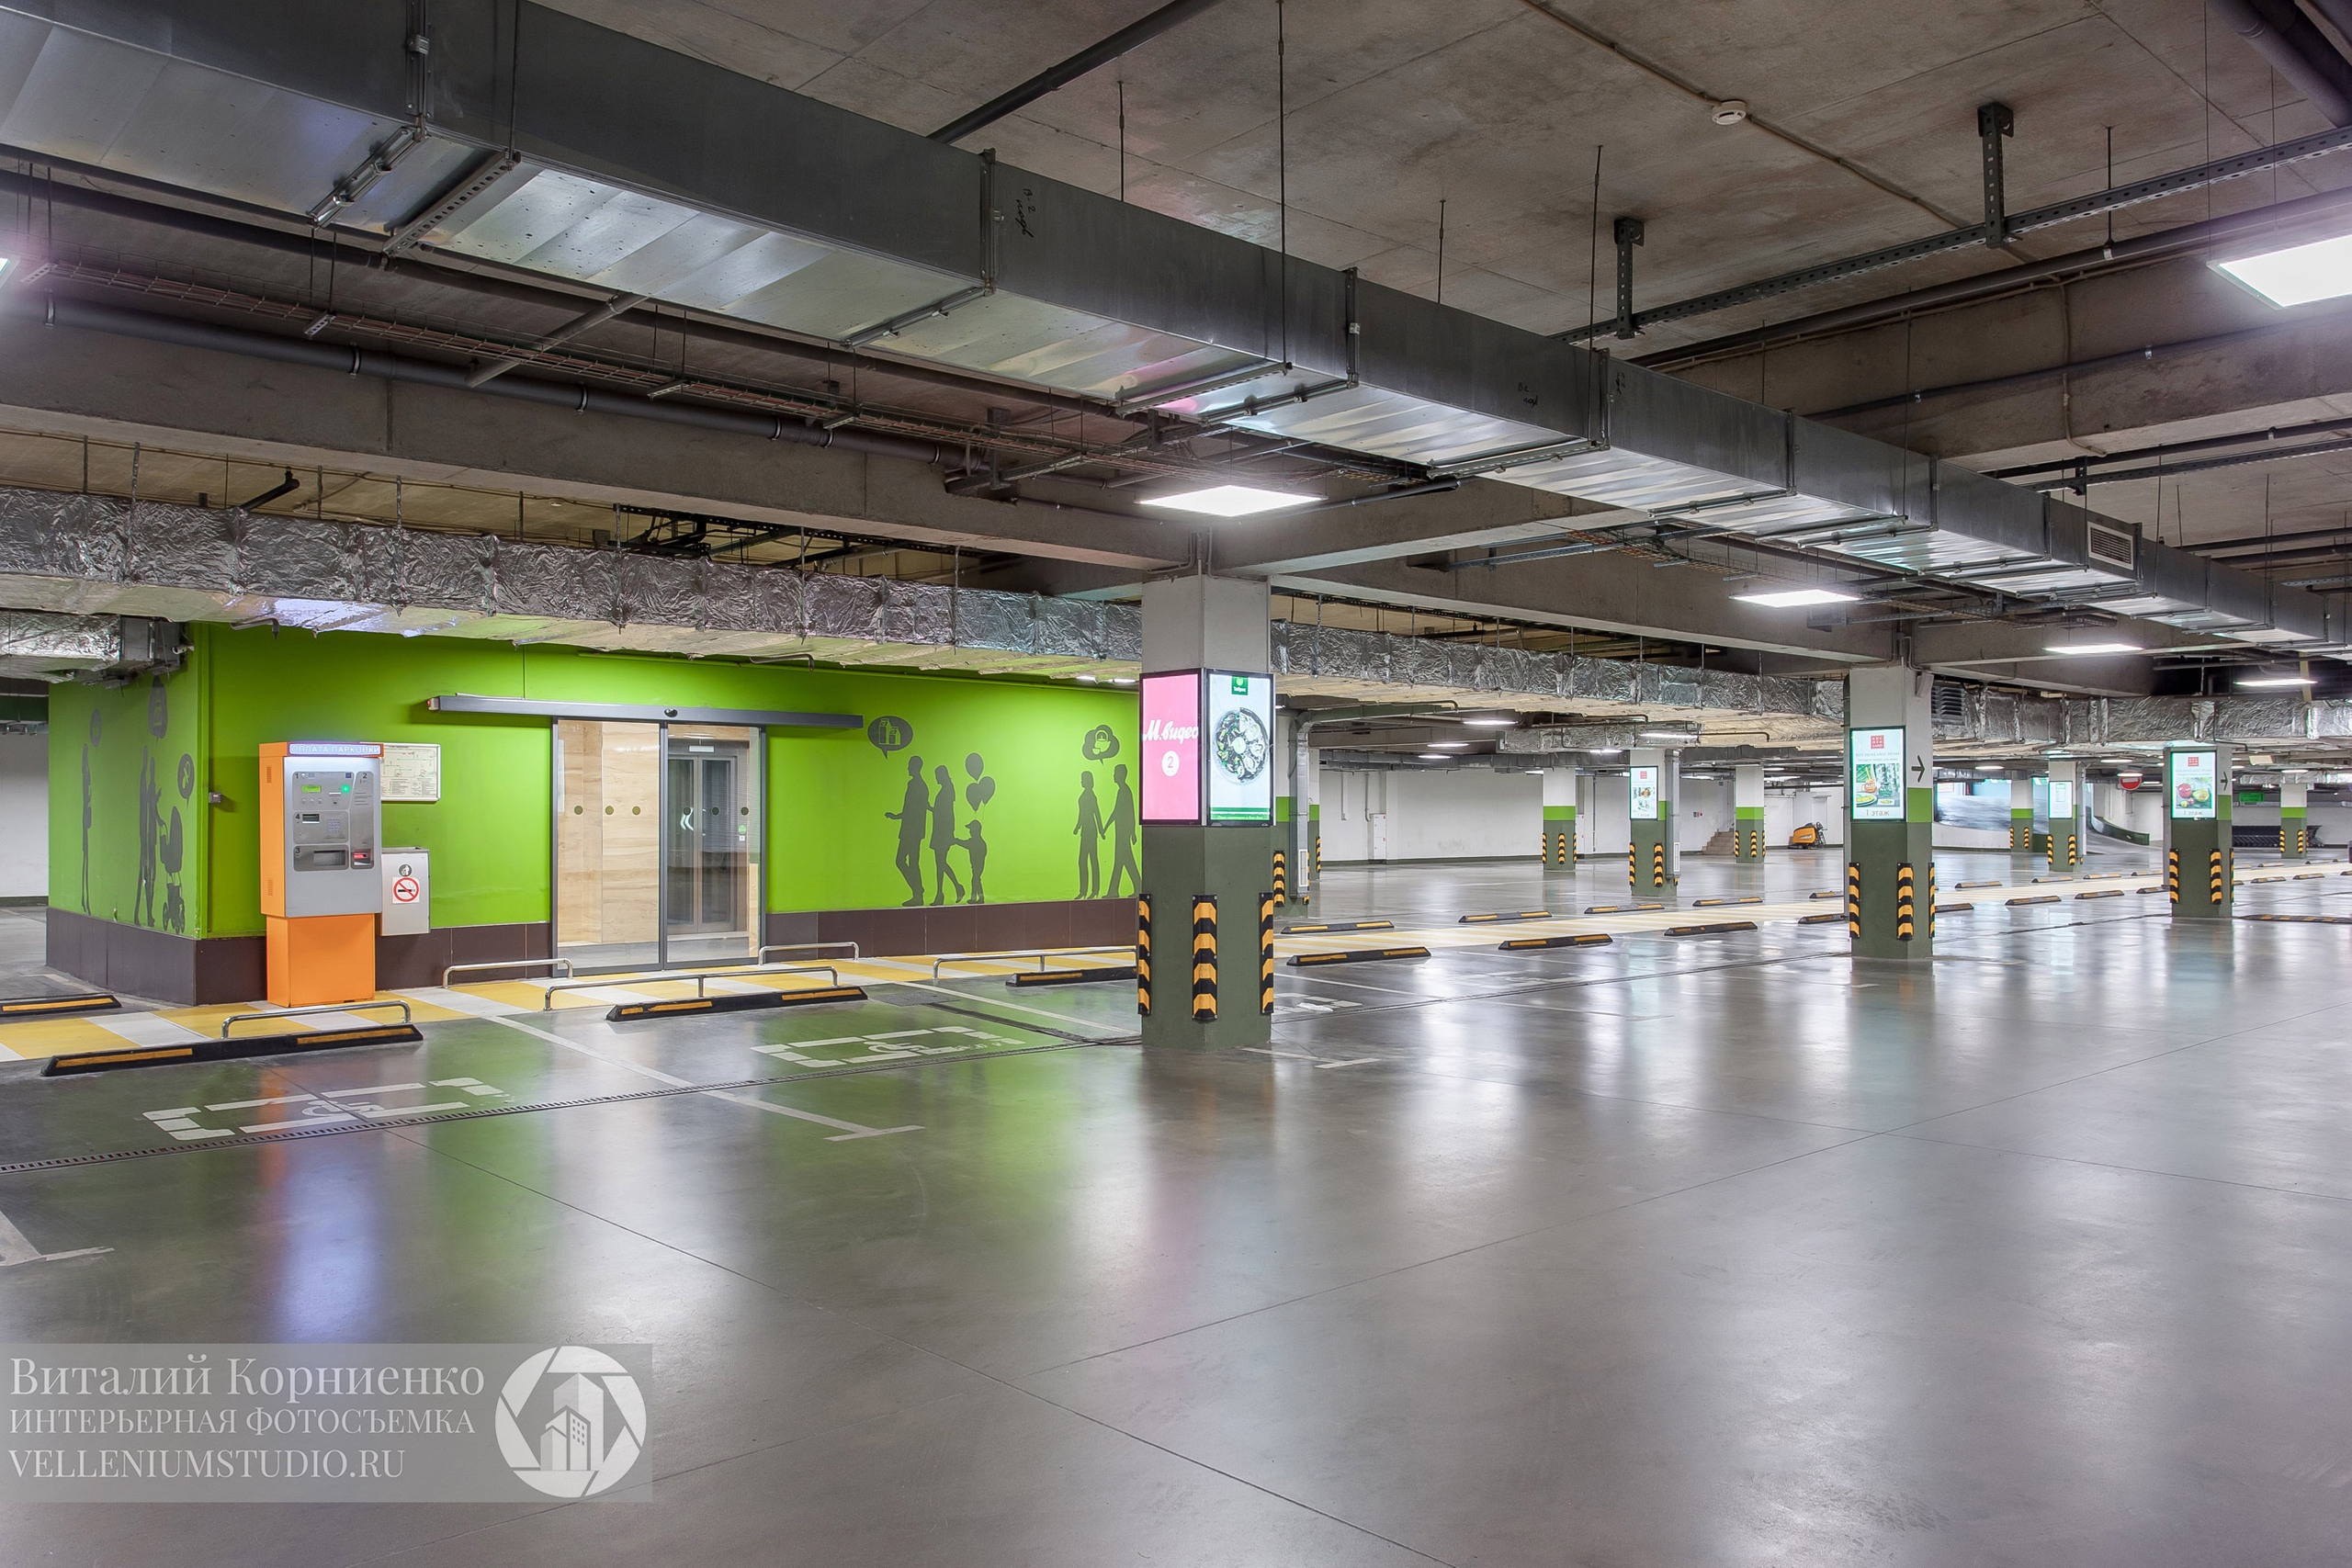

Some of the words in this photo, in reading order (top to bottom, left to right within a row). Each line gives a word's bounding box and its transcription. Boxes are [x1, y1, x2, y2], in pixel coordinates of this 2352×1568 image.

[1142, 719, 1199, 745] М.видео
[291, 745, 329, 753] ОПЛАТА
[331, 745, 380, 753] ПАРКОВКИ
[1167, 756, 1174, 769] 2
